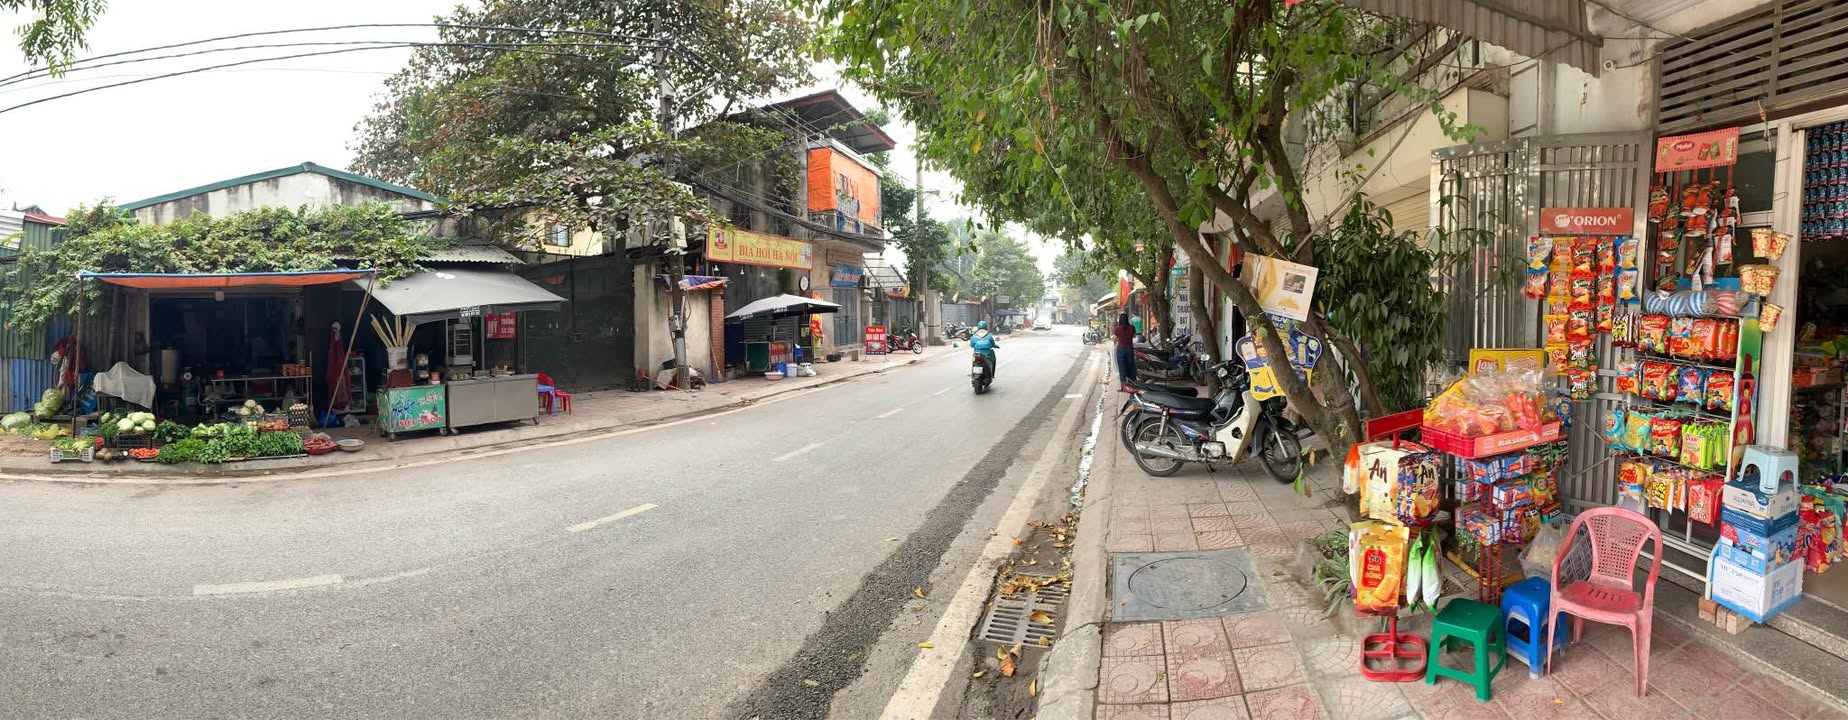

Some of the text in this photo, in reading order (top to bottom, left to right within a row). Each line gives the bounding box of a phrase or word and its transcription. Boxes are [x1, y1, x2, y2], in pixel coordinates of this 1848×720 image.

[1573, 215, 1617, 226] ORION
[739, 245, 754, 257] BIA
[1368, 457, 1388, 484] An
[1419, 464, 1436, 485] An
